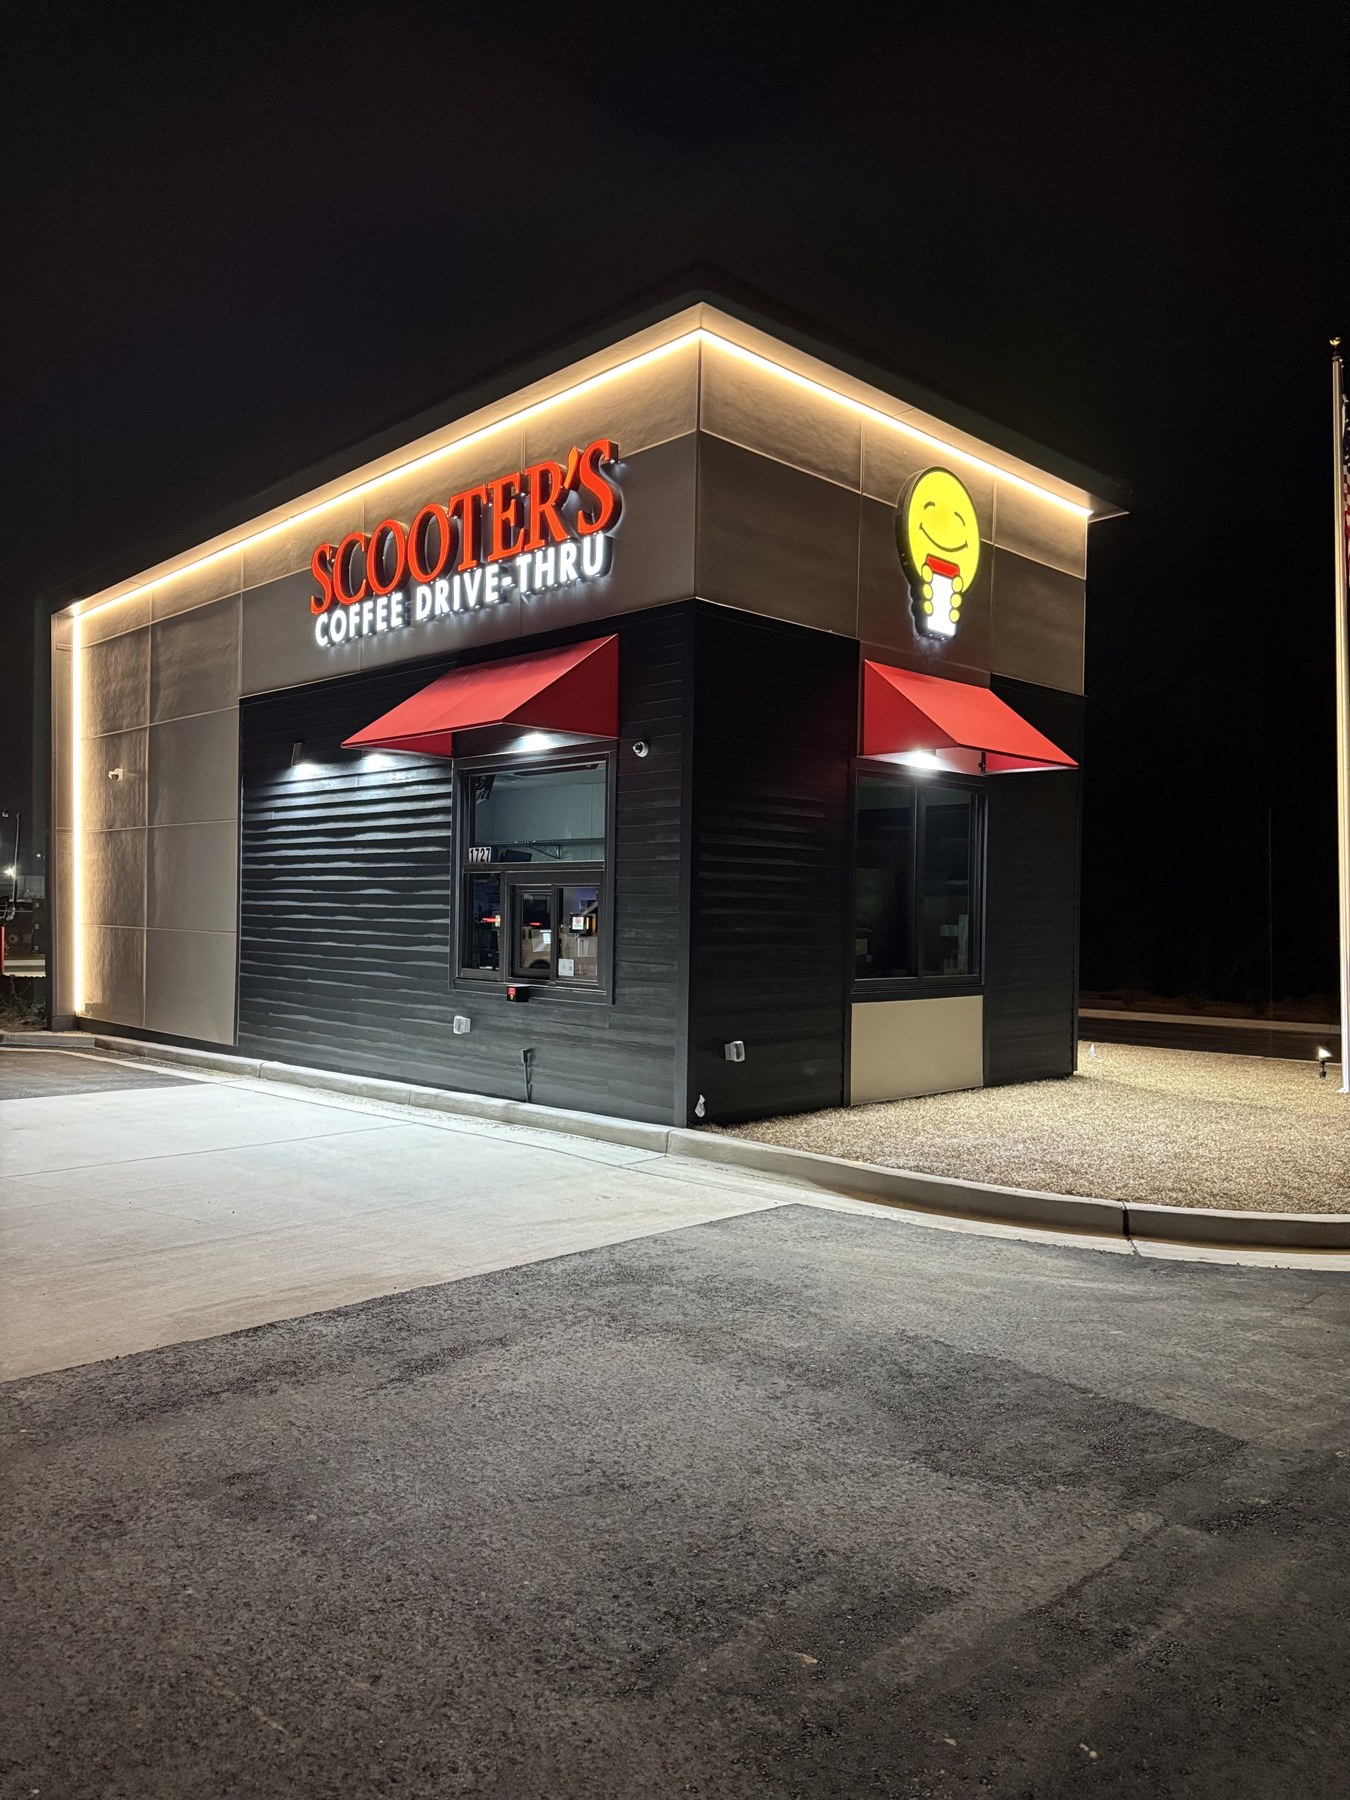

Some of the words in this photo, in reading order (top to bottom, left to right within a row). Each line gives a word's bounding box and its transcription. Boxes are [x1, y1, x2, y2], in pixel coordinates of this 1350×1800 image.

[311, 438, 616, 615] SCOOTER'S
[315, 592, 404, 647] COFFEE
[415, 532, 606, 621] DRIVE-THRU
[469, 847, 491, 863] 1727
